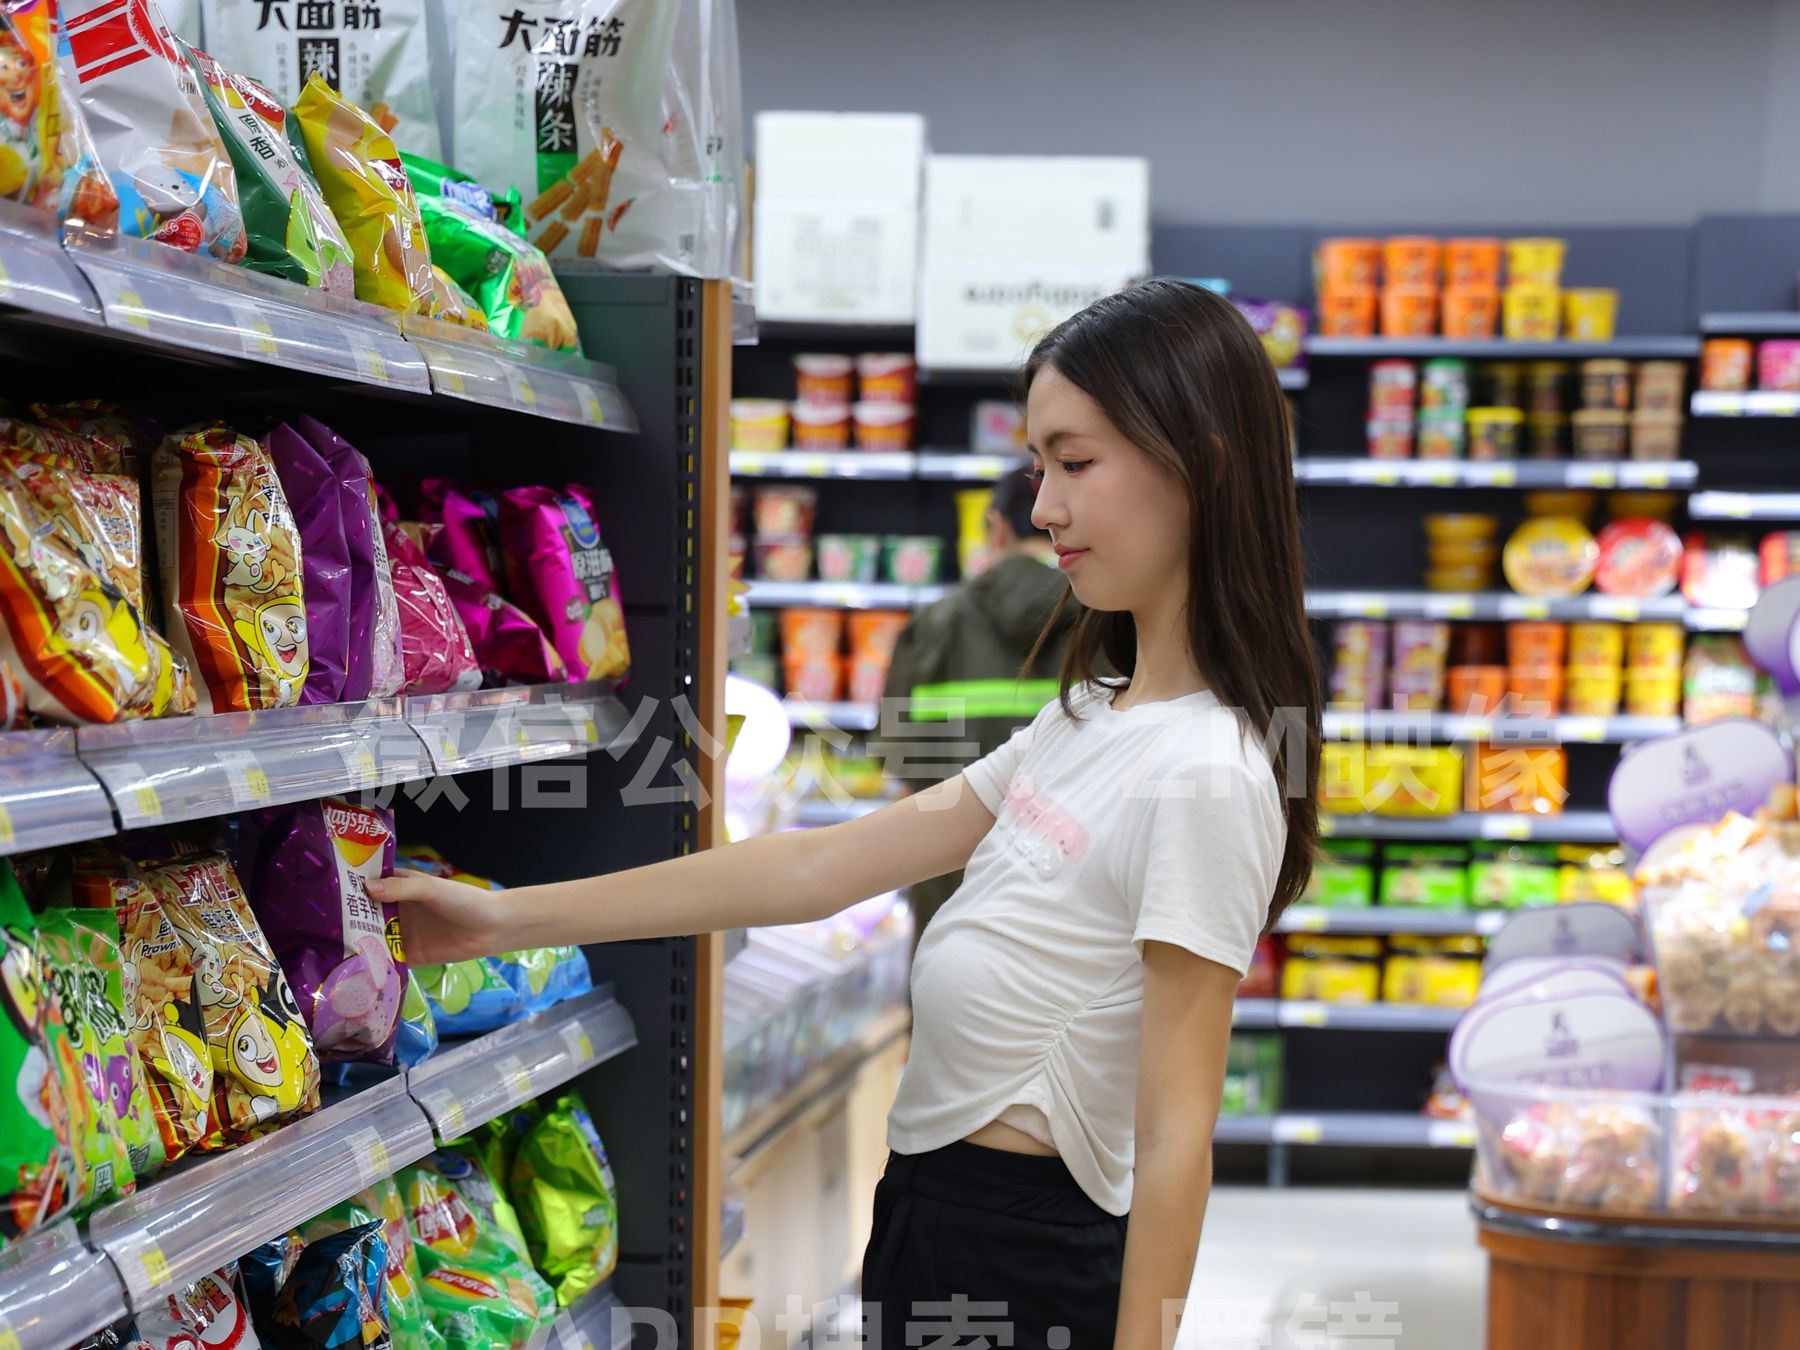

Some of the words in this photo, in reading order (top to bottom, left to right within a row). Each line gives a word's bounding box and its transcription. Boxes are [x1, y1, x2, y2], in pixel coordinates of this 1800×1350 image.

[499, 9, 625, 57] 大面筋
[536, 62, 574, 151] 辣条
[141, 943, 177, 957] Prawn
